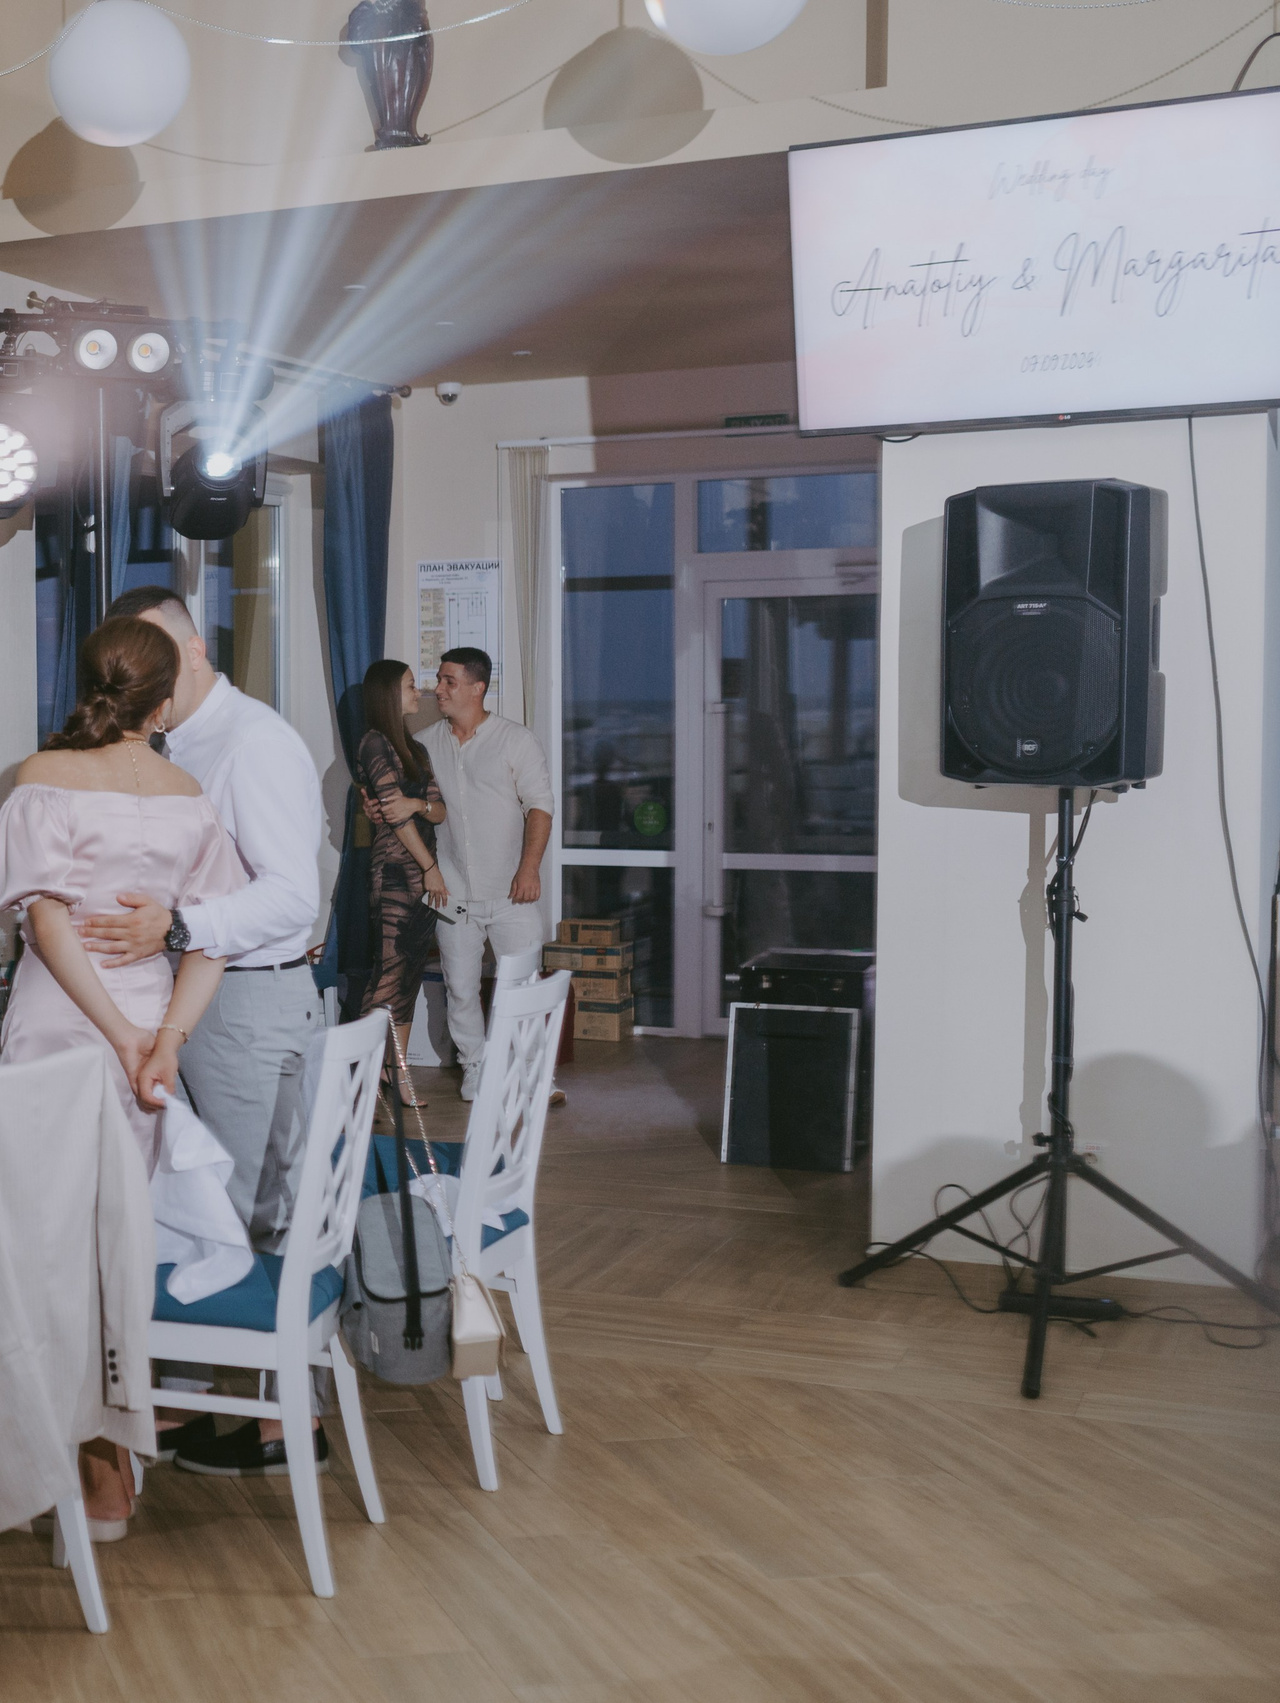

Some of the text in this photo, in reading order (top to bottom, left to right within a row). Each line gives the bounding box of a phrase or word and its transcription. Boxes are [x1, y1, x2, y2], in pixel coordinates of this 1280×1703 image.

[988, 154, 1117, 202] Wedding day
[1012, 257, 1036, 292] &
[1053, 217, 1280, 318] Margarita
[420, 561, 500, 572] ПЛАН ЭВАКУАЦИИ
